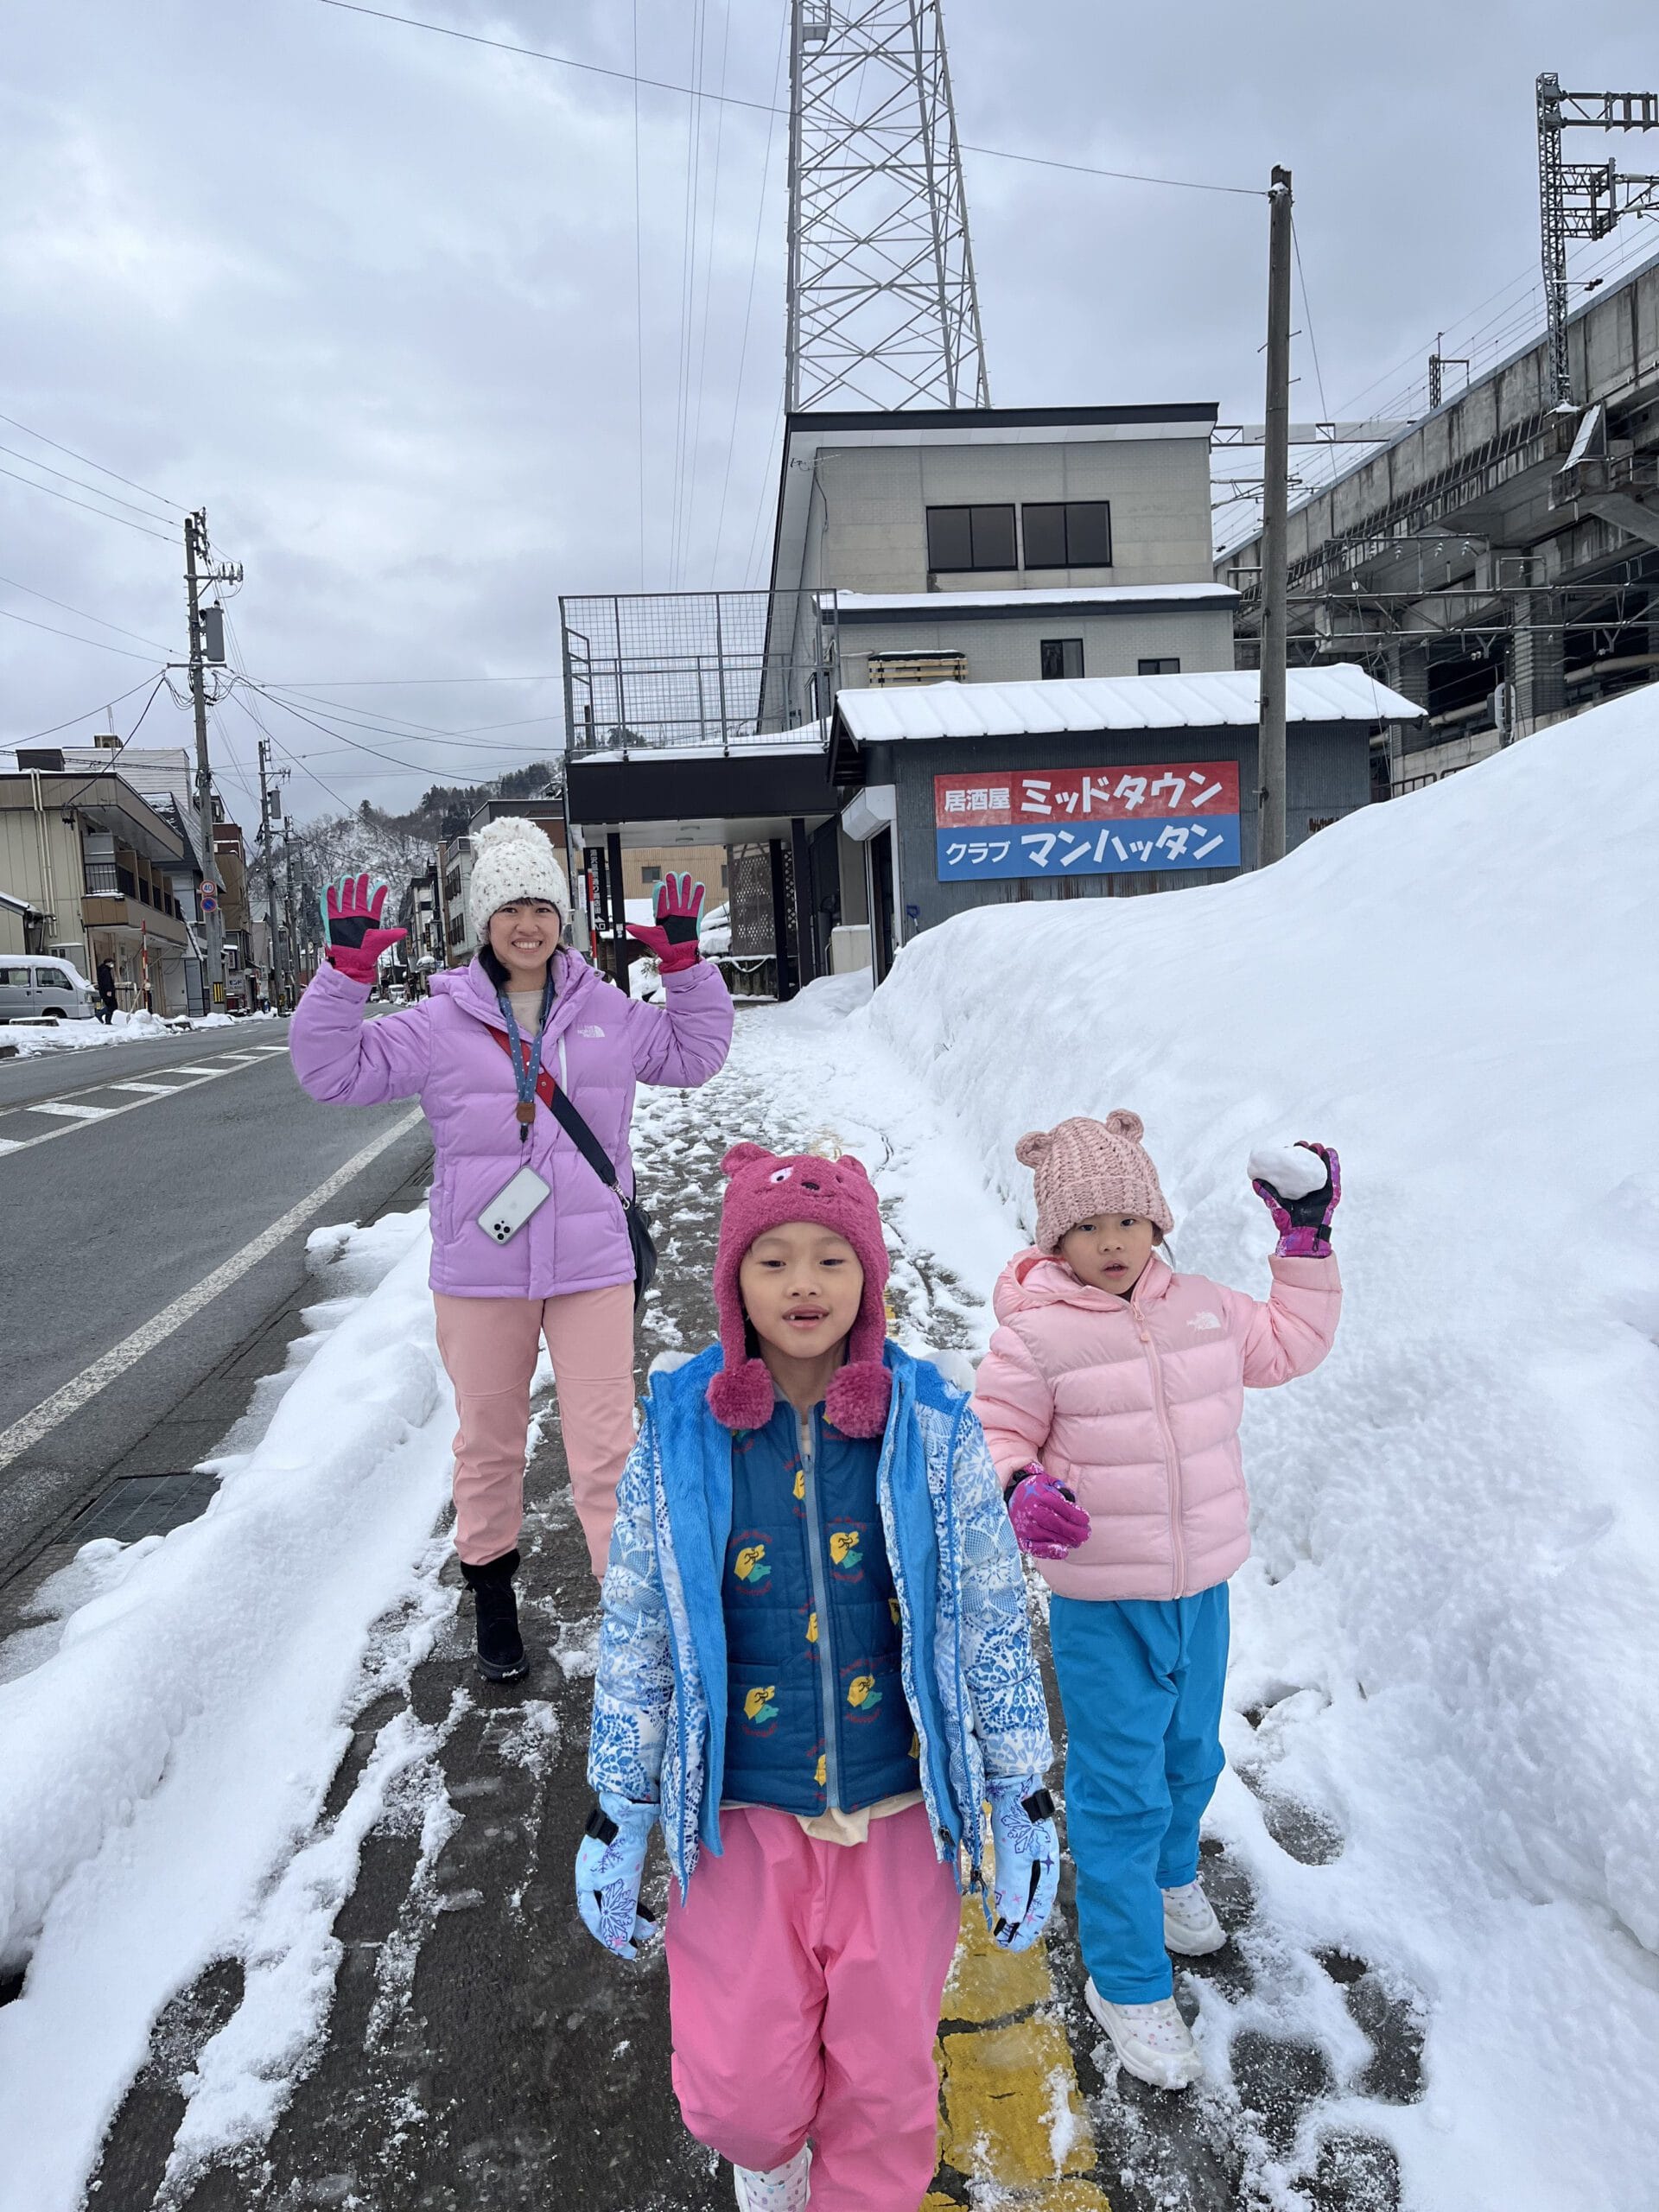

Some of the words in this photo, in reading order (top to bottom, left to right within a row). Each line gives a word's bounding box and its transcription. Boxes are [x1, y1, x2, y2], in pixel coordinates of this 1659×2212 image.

[944, 787, 1010, 812] 居酒屋
[1020, 771, 1223, 815] ミッドタウン
[946, 840, 1011, 866] クラブ
[1020, 823, 1224, 868] マンハッタン
